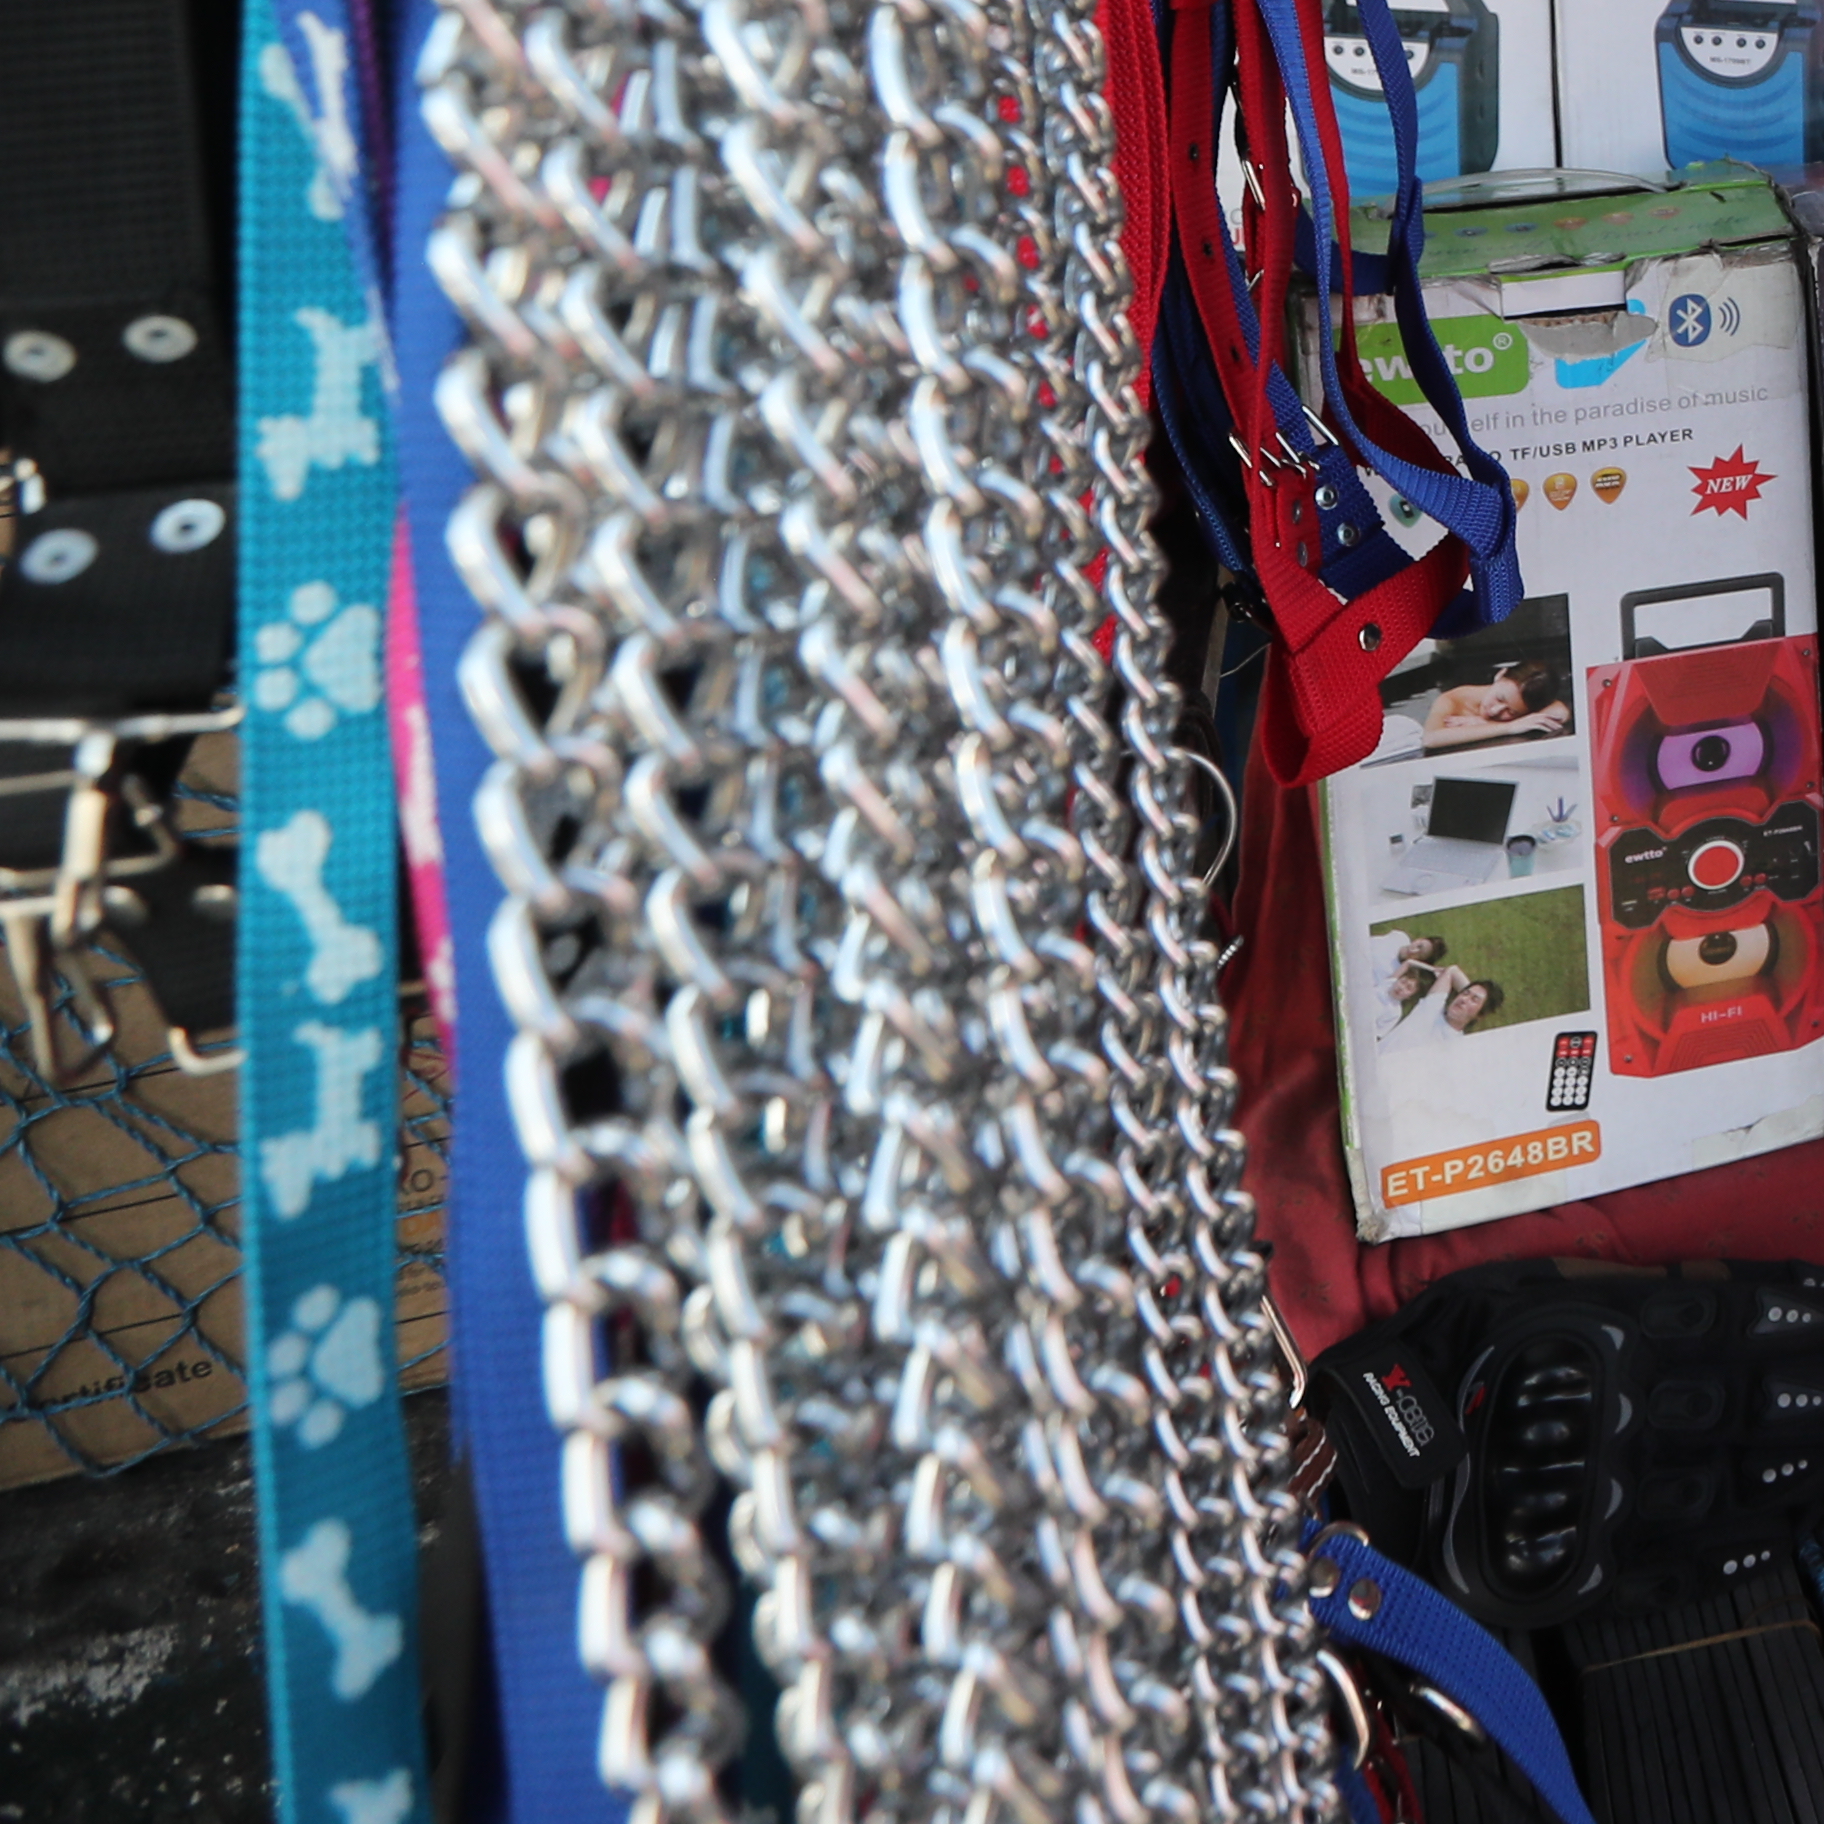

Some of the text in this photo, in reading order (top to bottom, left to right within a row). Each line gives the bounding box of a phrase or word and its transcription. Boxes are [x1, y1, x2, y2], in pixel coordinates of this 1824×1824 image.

[1505, 385, 1769, 429] in the paradise of music
[1510, 427, 1694, 461] TF/USB MP3 PLAYER
[1704, 475, 1752, 494] NEW
[1625, 848, 1663, 864] ewtto
[1701, 1006, 1743, 1023] HI-FI
[1387, 1131, 1595, 1197] ET-P2648BR
[1363, 1372, 1390, 1406] RACING
[1384, 1406, 1420, 1457] EQUIPMENT
